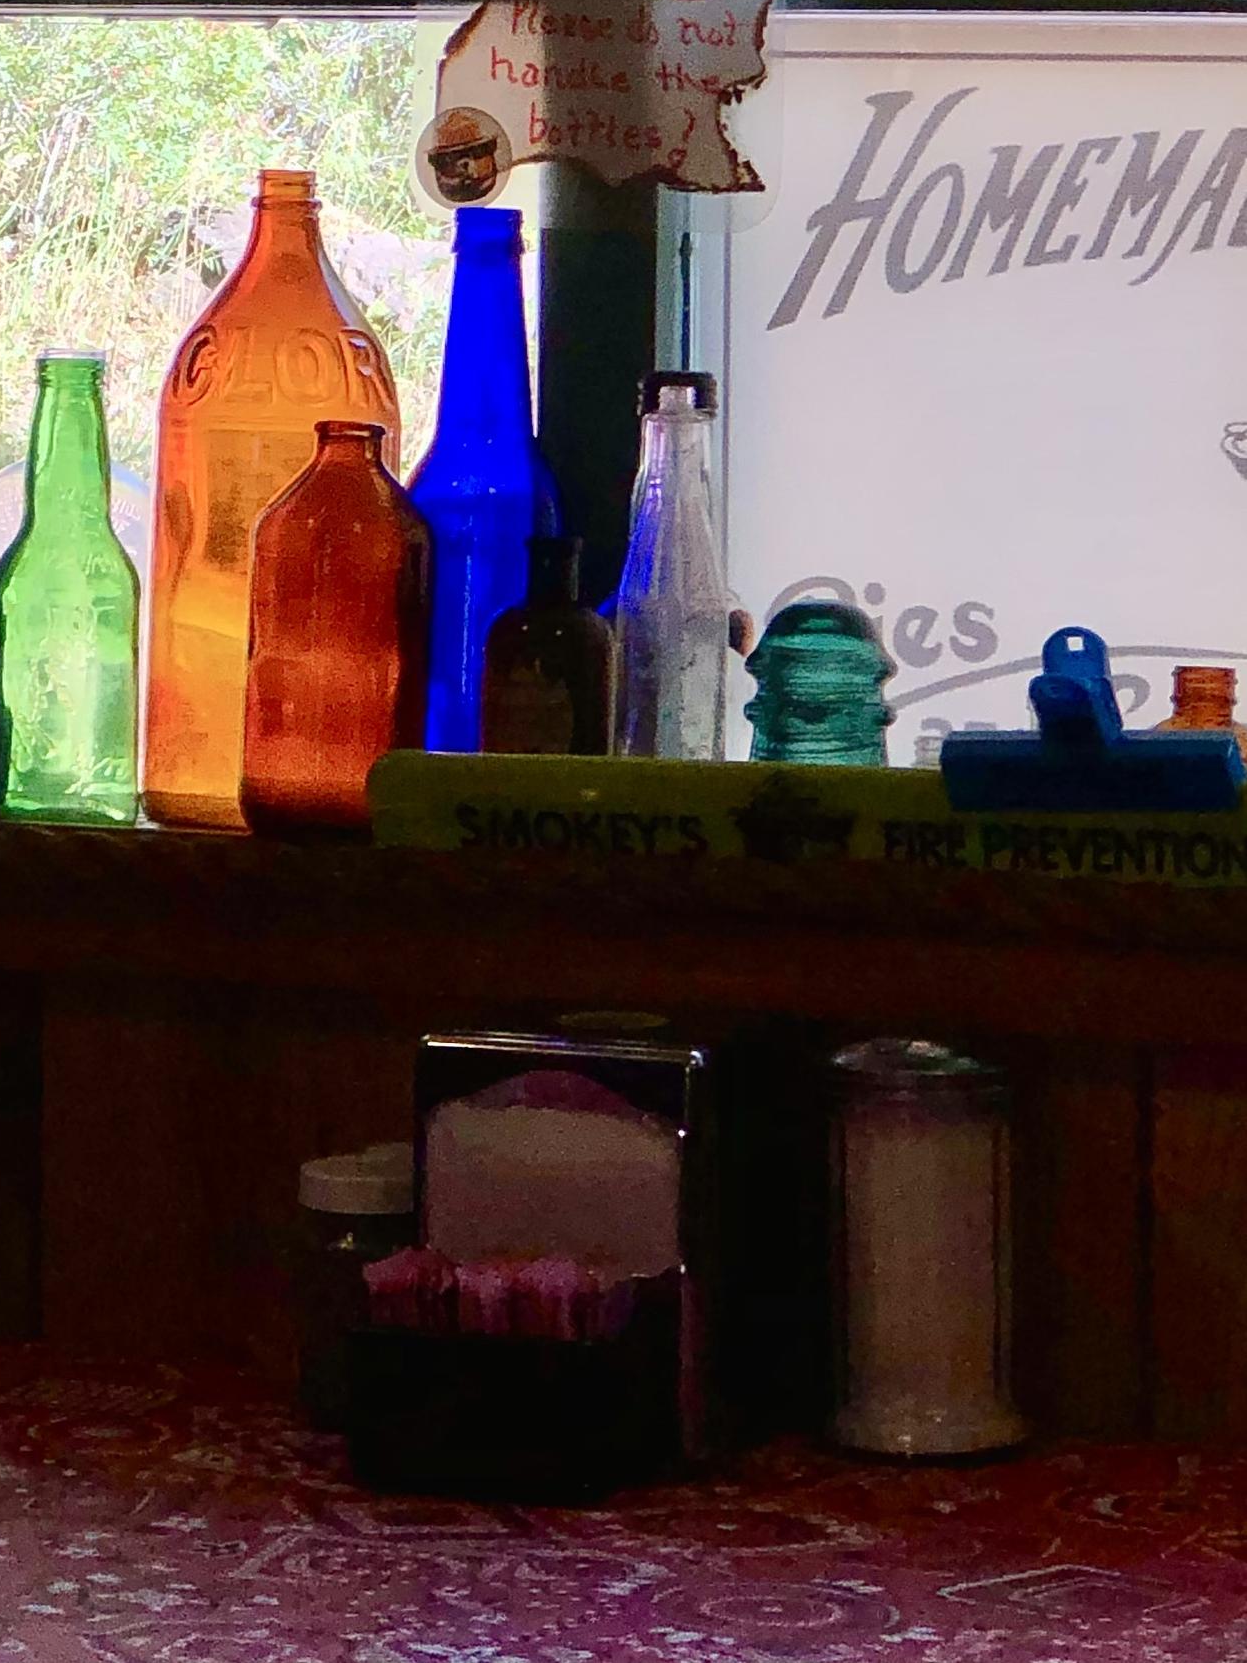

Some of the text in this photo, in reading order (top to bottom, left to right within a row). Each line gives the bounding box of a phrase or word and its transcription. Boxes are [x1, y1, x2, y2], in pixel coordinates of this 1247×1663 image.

[510, 0, 615, 41] Please
[676, 9, 738, 47] not
[490, 45, 722, 96] handle the
[456, 803, 708, 855] SMOKEY'S
[884, 820, 967, 868] FIRE
